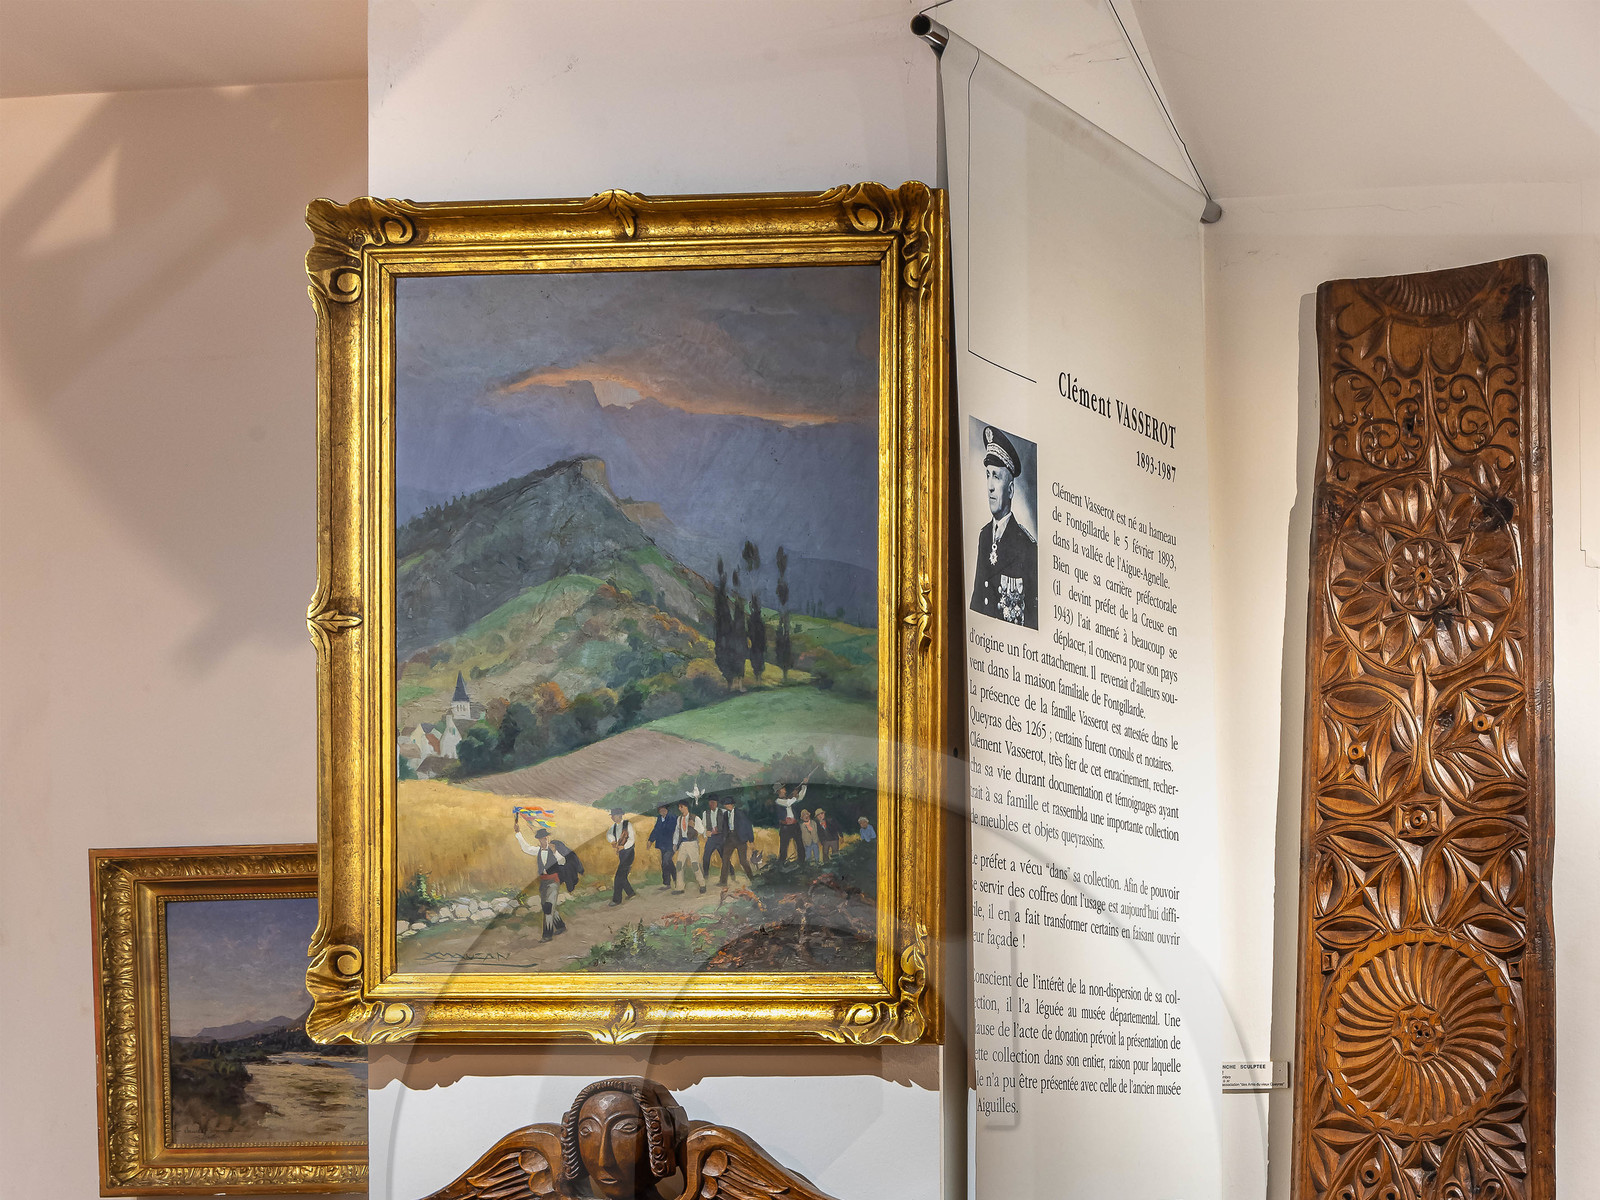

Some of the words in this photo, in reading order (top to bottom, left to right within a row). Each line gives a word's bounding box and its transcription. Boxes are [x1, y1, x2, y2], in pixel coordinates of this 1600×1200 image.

[1059, 371, 1112, 418] Clément
[1117, 398, 1177, 449] VASSEROT
[1137, 450, 1177, 482] 1893-1987
[1052, 481, 1083, 507] Clément
[1084, 495, 1115, 520] Vasserot
[1116, 512, 1127, 525] est
[1149, 521, 1177, 545] hameau
[1052, 530, 1070, 550] dans
[1081, 544, 1104, 563] vallée
[1066, 511, 1110, 542] Fontgillarde
[1133, 537, 1154, 560] février
[1158, 549, 1177, 571] 1893,
[1053, 554, 1070, 574] Bien
[1074, 567, 1089, 583] que
[1106, 579, 1133, 597] carrière
[1136, 589, 1178, 613] préfectorale
[1054, 604, 1074, 625] 1943)
[1095, 622, 1120, 640] amené
[1132, 630, 1165, 659] beaucoup
[1069, 584, 1092, 606] devint
[1095, 598, 1117, 615] préfet
[1141, 612, 1165, 632] Creuse
[1023, 642, 1039, 662] fort
[1041, 652, 1089, 677] attachement.
[1101, 672, 1129, 690] revenait
[1162, 691, 1178, 703] sou-
[1053, 628, 1087, 655] déplacer,
[1096, 646, 1127, 666] conserva
[1129, 658, 1145, 672] pour
[1147, 663, 1159, 676] son
[1161, 668, 1178, 684] pays
[970, 656, 985, 672] vent
[988, 659, 1010, 679] dans
[1025, 673, 1056, 691] maison
[1059, 677, 1090, 701] familiale
[1104, 692, 1146, 718] Fontgillarde.
[970, 704, 1003, 728] Queyras
[1005, 714, 1023, 732] dès
[1026, 719, 1047, 739] 1265
[1055, 730, 1083, 748] certains
[1085, 734, 1107, 754] furent
[1109, 745, 1135, 762] consuls
[1145, 755, 1174, 771] notaires.
[981, 685, 1021, 707] présence
[1052, 700, 1076, 722] famille
[1079, 709, 1109, 731] Vasserot
[1112, 722, 1122, 735] est
[1124, 726, 1149, 742] attestée
[1151, 730, 1168, 747] dans
[970, 730, 1002, 753] Clément
[1005, 739, 1046, 765] Vasserot,
[1049, 750, 1063, 767] très
[1065, 752, 1077, 770] fier
[1091, 764, 1102, 777] cet
[1104, 768, 1151, 790] enracinement,
[1153, 778, 1179, 795] recher-
[997, 764, 1012, 780] vie
[1015, 766, 1046, 787] durant
[1049, 773, 1104, 801] documentation
[1115, 791, 1157, 816] témoignages
[1159, 805, 1179, 819] ayant
[1007, 789, 1039, 810] famille
[1053, 804, 1088, 821] rassembla
[1090, 812, 1105, 825] une
[1107, 812, 1144, 834] importante
[1145, 822, 1180, 841] collection
[981, 813, 1019, 832] meubles
[1034, 820, 1060, 841] objets
[1061, 830, 1105, 849] queyrassins.
[979, 852, 1008, 871] préfet
[1020, 859, 1043, 875] vécu
[1083, 870, 1122, 889] collection.
[1124, 877, 1138, 893] Afin
[1151, 886, 1180, 900] pouvoir
[979, 880, 1005, 895] servir
[1008, 880, 1026, 898] des
[1029, 884, 1059, 903] coffres
[1061, 889, 1078, 906] dont
[1108, 901, 1119, 913] est
[1161, 906, 1180, 922] diffi-
[987, 927, 1019, 949] façade
[1025, 907, 1041, 925] fait
[1044, 913, 1088, 932] transformer
[1091, 922, 1120, 936] certains
[1133, 924, 1155, 942] faisant
[1157, 931, 1181, 945] ouvrir
[974, 967, 1013, 988] onscient
[1089, 982, 1142, 1002] non-dispersion
[1165, 989, 1181, 1003] col-
[1036, 998, 1064, 1019] léguée
[1082, 1005, 1106, 1020] musée
[1110, 1006, 1160, 1026] départemental.
[1164, 1012, 1181, 1027] Une
[975, 1048, 989, 1060] ette
[992, 1046, 1040, 1064] collection
[1044, 1049, 1064, 1065] dans
[1065, 1055, 1080, 1067] son
[1082, 1053, 1106, 1070] entier,
[1109, 1055, 1131, 1069] raison
[1133, 1060, 1149, 1074] pour
[1152, 1056, 1182, 1076] laquelle
[1055, 1025, 1089, 1043] donation
[1090, 1029, 1117, 1048] prévoit
[1127, 1032, 1169, 1050] présentation
[1170, 1034, 1181, 1049] de
[976, 1095, 1019, 1117] Aiguilles.
[1018, 1072, 1039, 1088] être
[1041, 1074, 1080, 1093] présentée
[1080, 1080, 1099, 1092] avec
[1100, 1077, 1118, 1092] celle
[1157, 1081, 1182, 1095] musée
